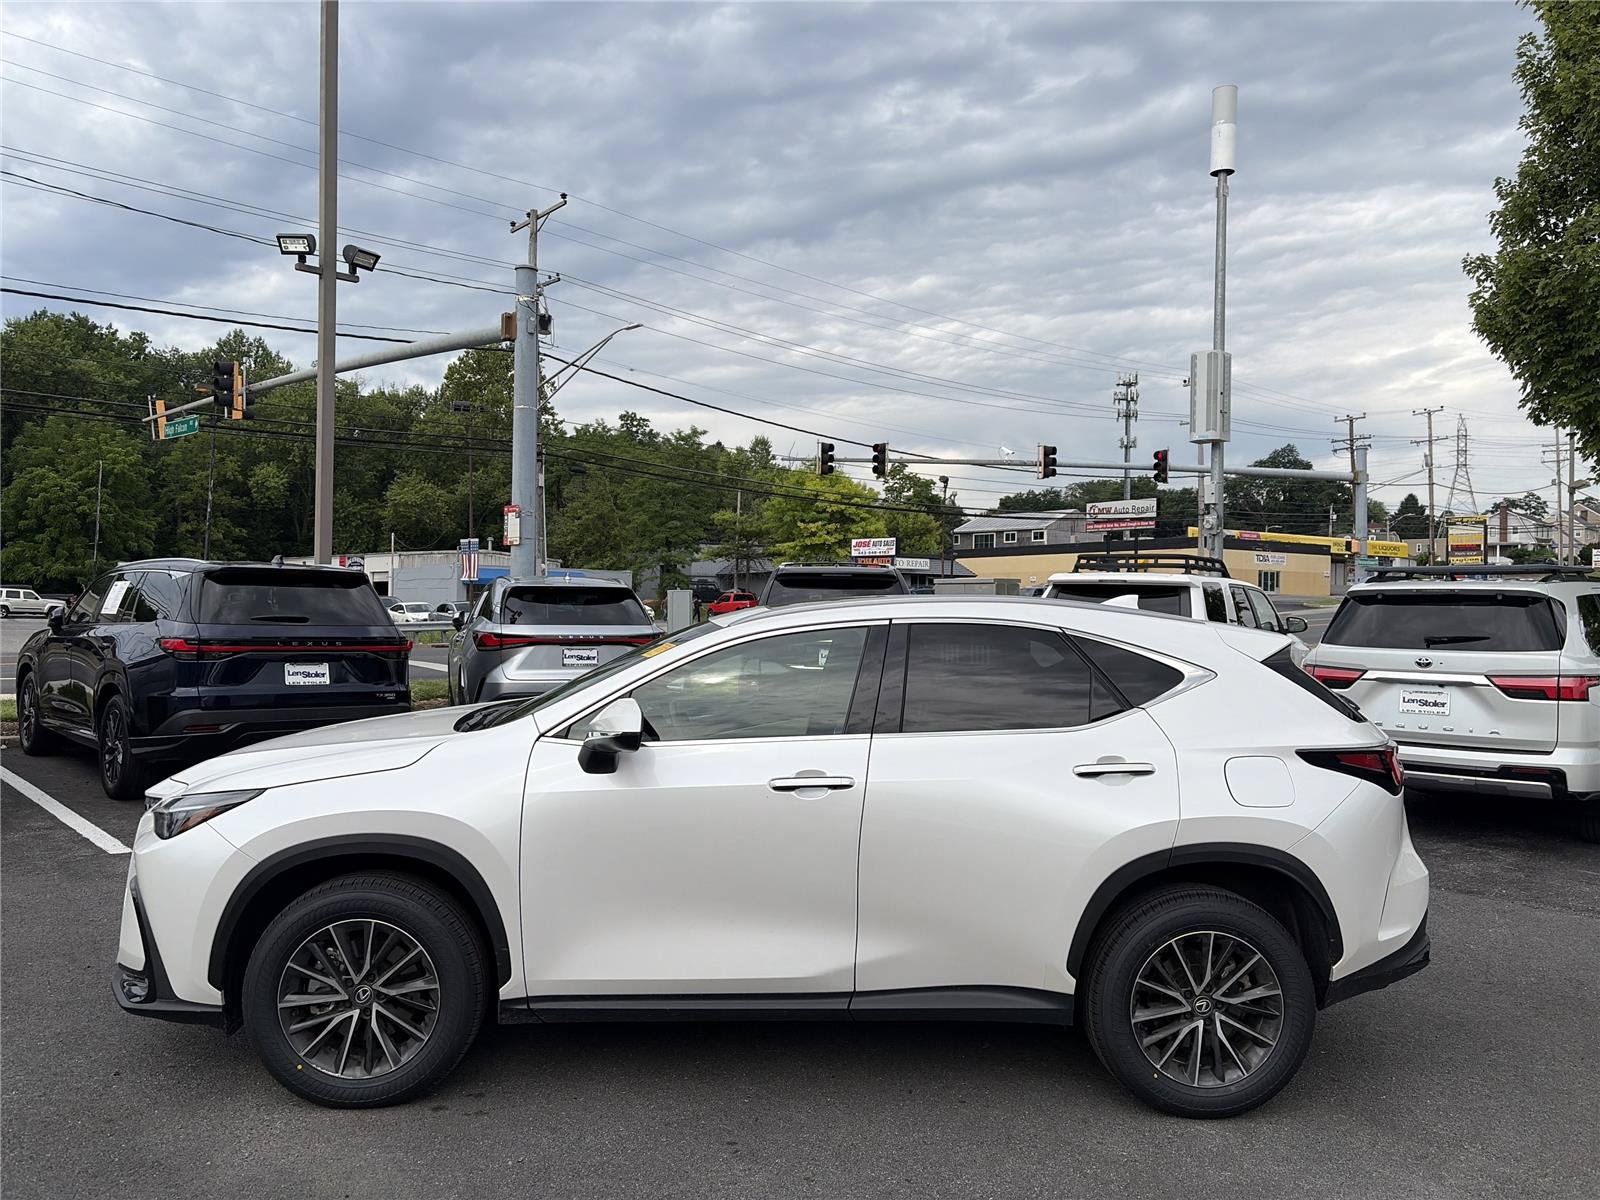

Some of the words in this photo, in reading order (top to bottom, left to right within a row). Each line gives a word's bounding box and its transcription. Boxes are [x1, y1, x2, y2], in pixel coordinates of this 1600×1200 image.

[1113, 506, 1130, 514] Auto
[1132, 504, 1155, 513] Repair
[853, 540, 872, 548] JOSÉ
[883, 539, 896, 547] SALES
[1378, 545, 1401, 553] LIQUORS
[873, 557, 892, 565] AUTO
[907, 560, 929, 569] REPAIR
[1374, 722, 1501, 736] EQUOIA
